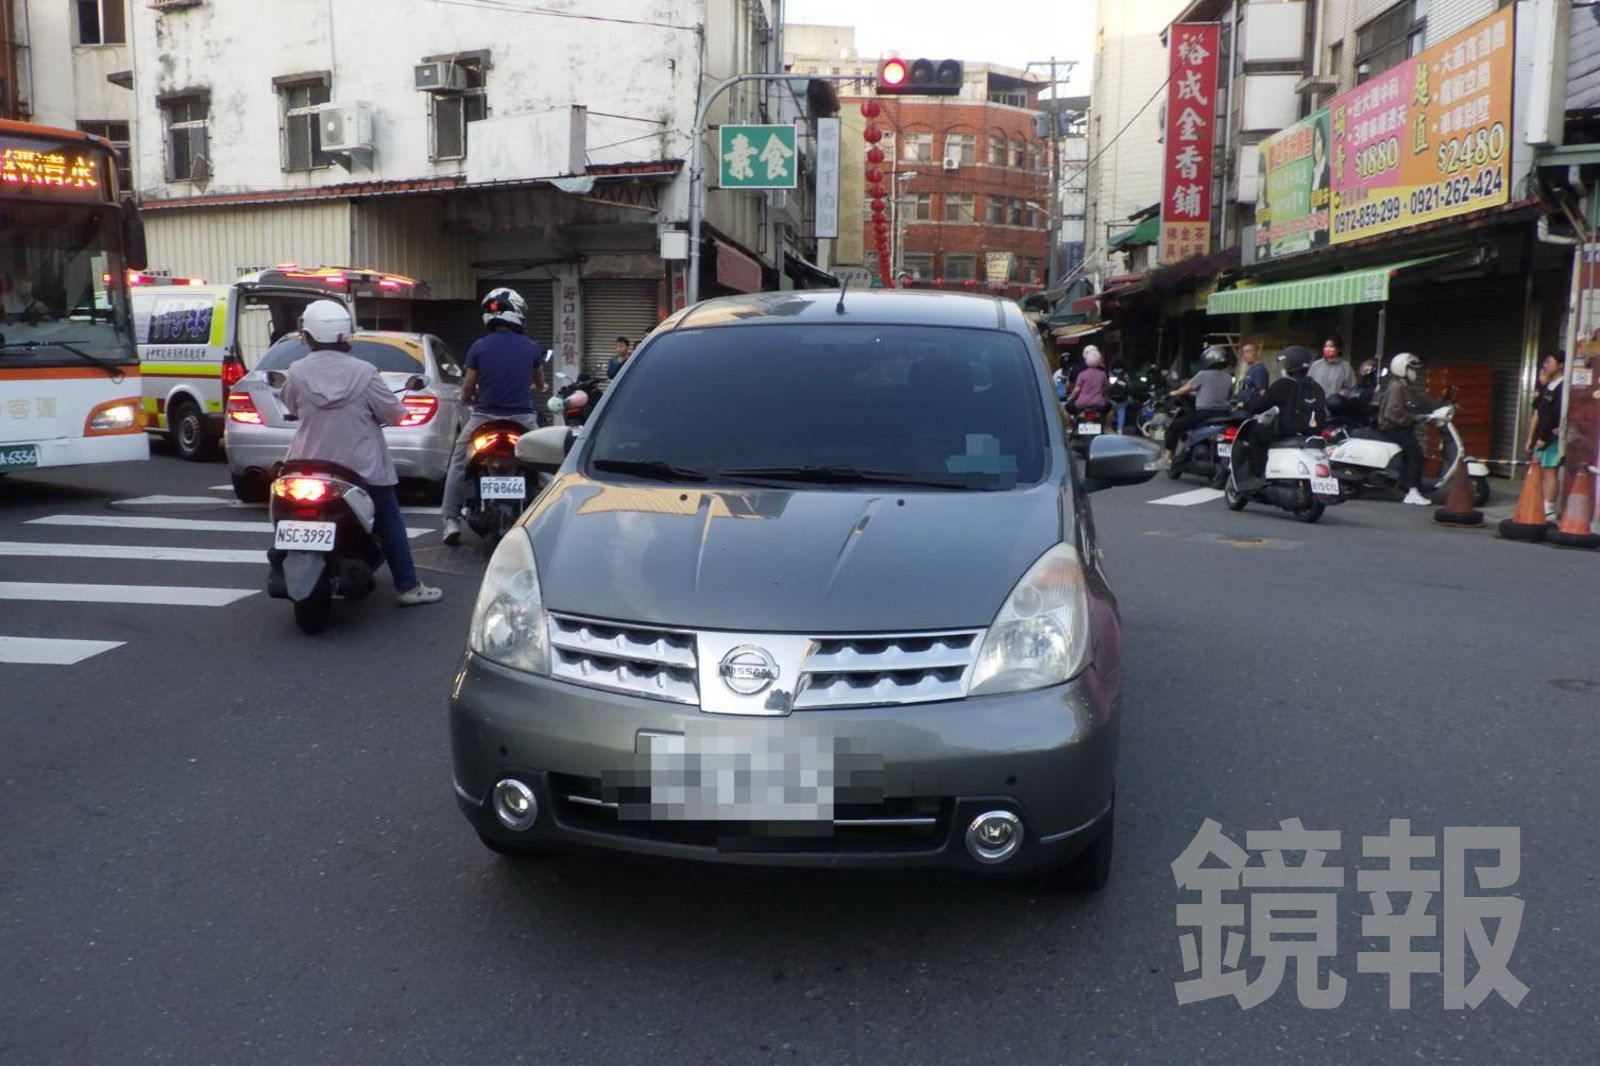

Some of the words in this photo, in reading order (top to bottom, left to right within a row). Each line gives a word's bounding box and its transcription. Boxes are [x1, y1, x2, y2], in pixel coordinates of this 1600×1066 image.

[1172, 33, 1211, 218] 裕成金香鋪
[1437, 121, 1505, 175] $2480
[723, 132, 794, 182] 素食
[1355, 135, 1400, 180] $1880
[1334, 196, 1400, 235] 0972-859-299
[1410, 166, 1503, 216] 0921-262-424
[276, 526, 334, 545] NSC-3992
[724, 664, 774, 680] NISSAN
